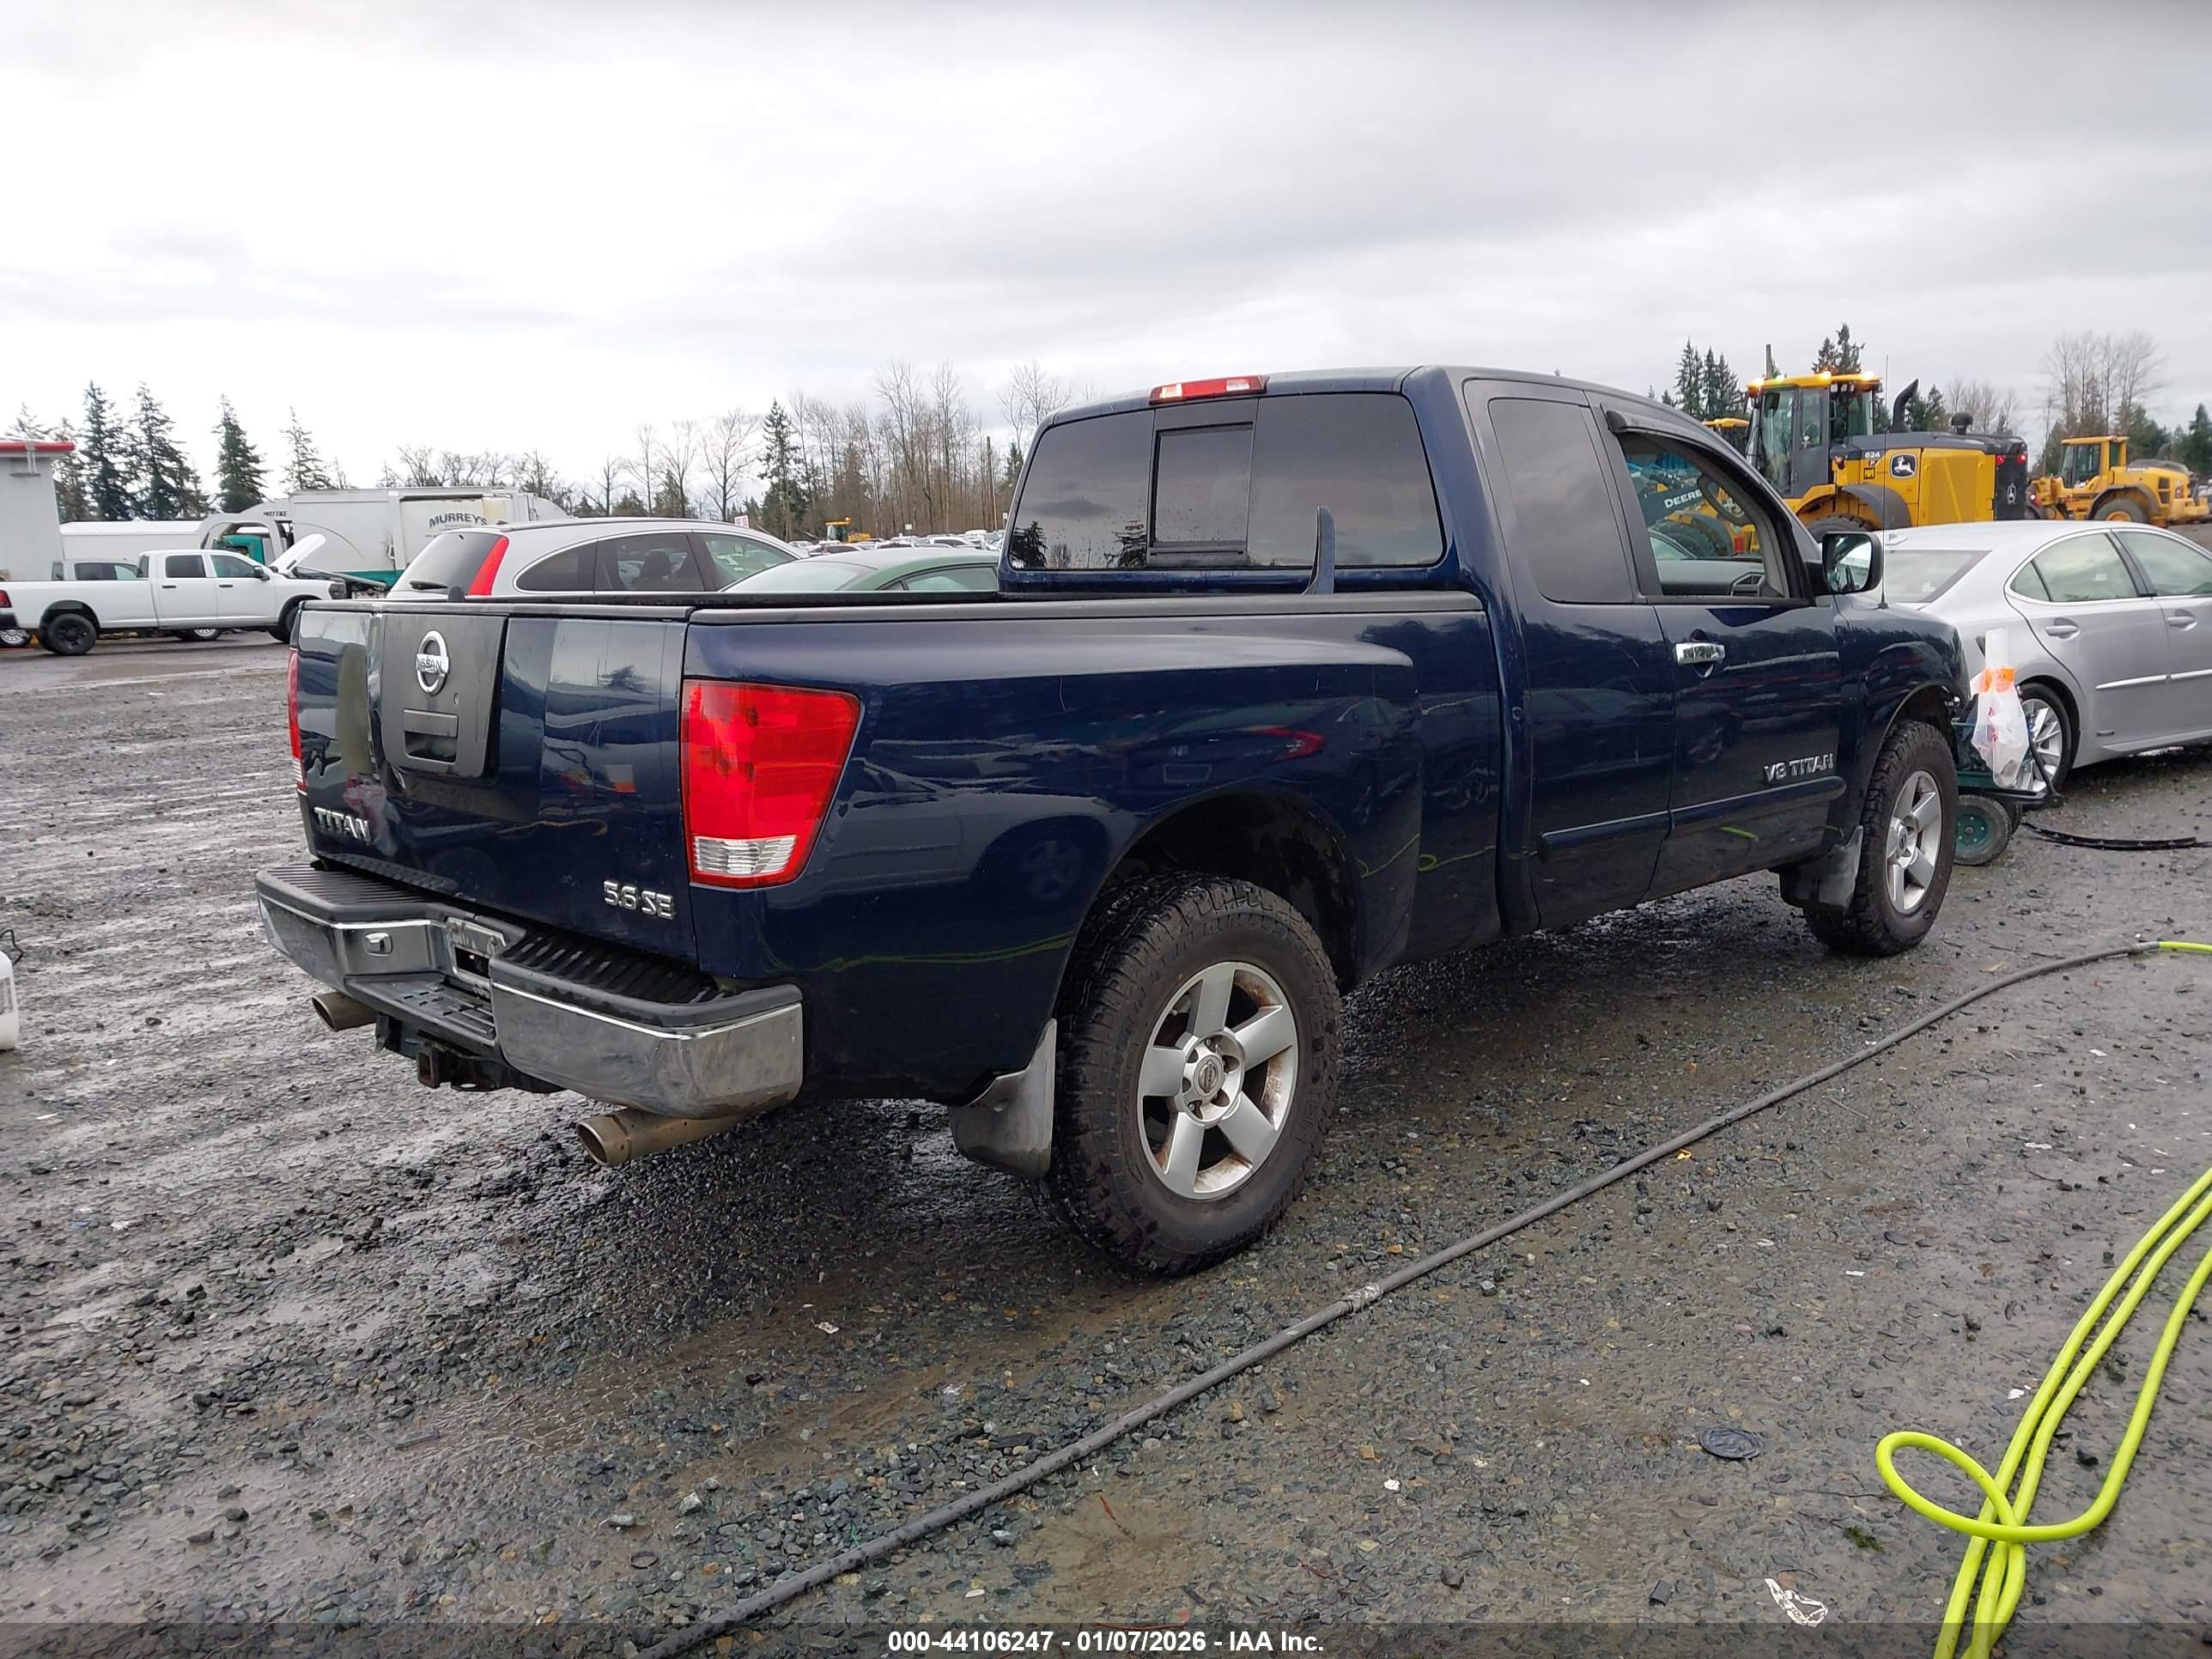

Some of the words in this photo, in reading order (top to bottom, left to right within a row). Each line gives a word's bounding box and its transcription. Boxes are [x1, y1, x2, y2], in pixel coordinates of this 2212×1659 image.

[1763, 763, 1786, 781] V8
[1789, 753, 1833, 776] TITAN
[313, 806, 372, 845] TITAN
[604, 880, 637, 910] 5.6
[641, 890, 673, 920] SE
